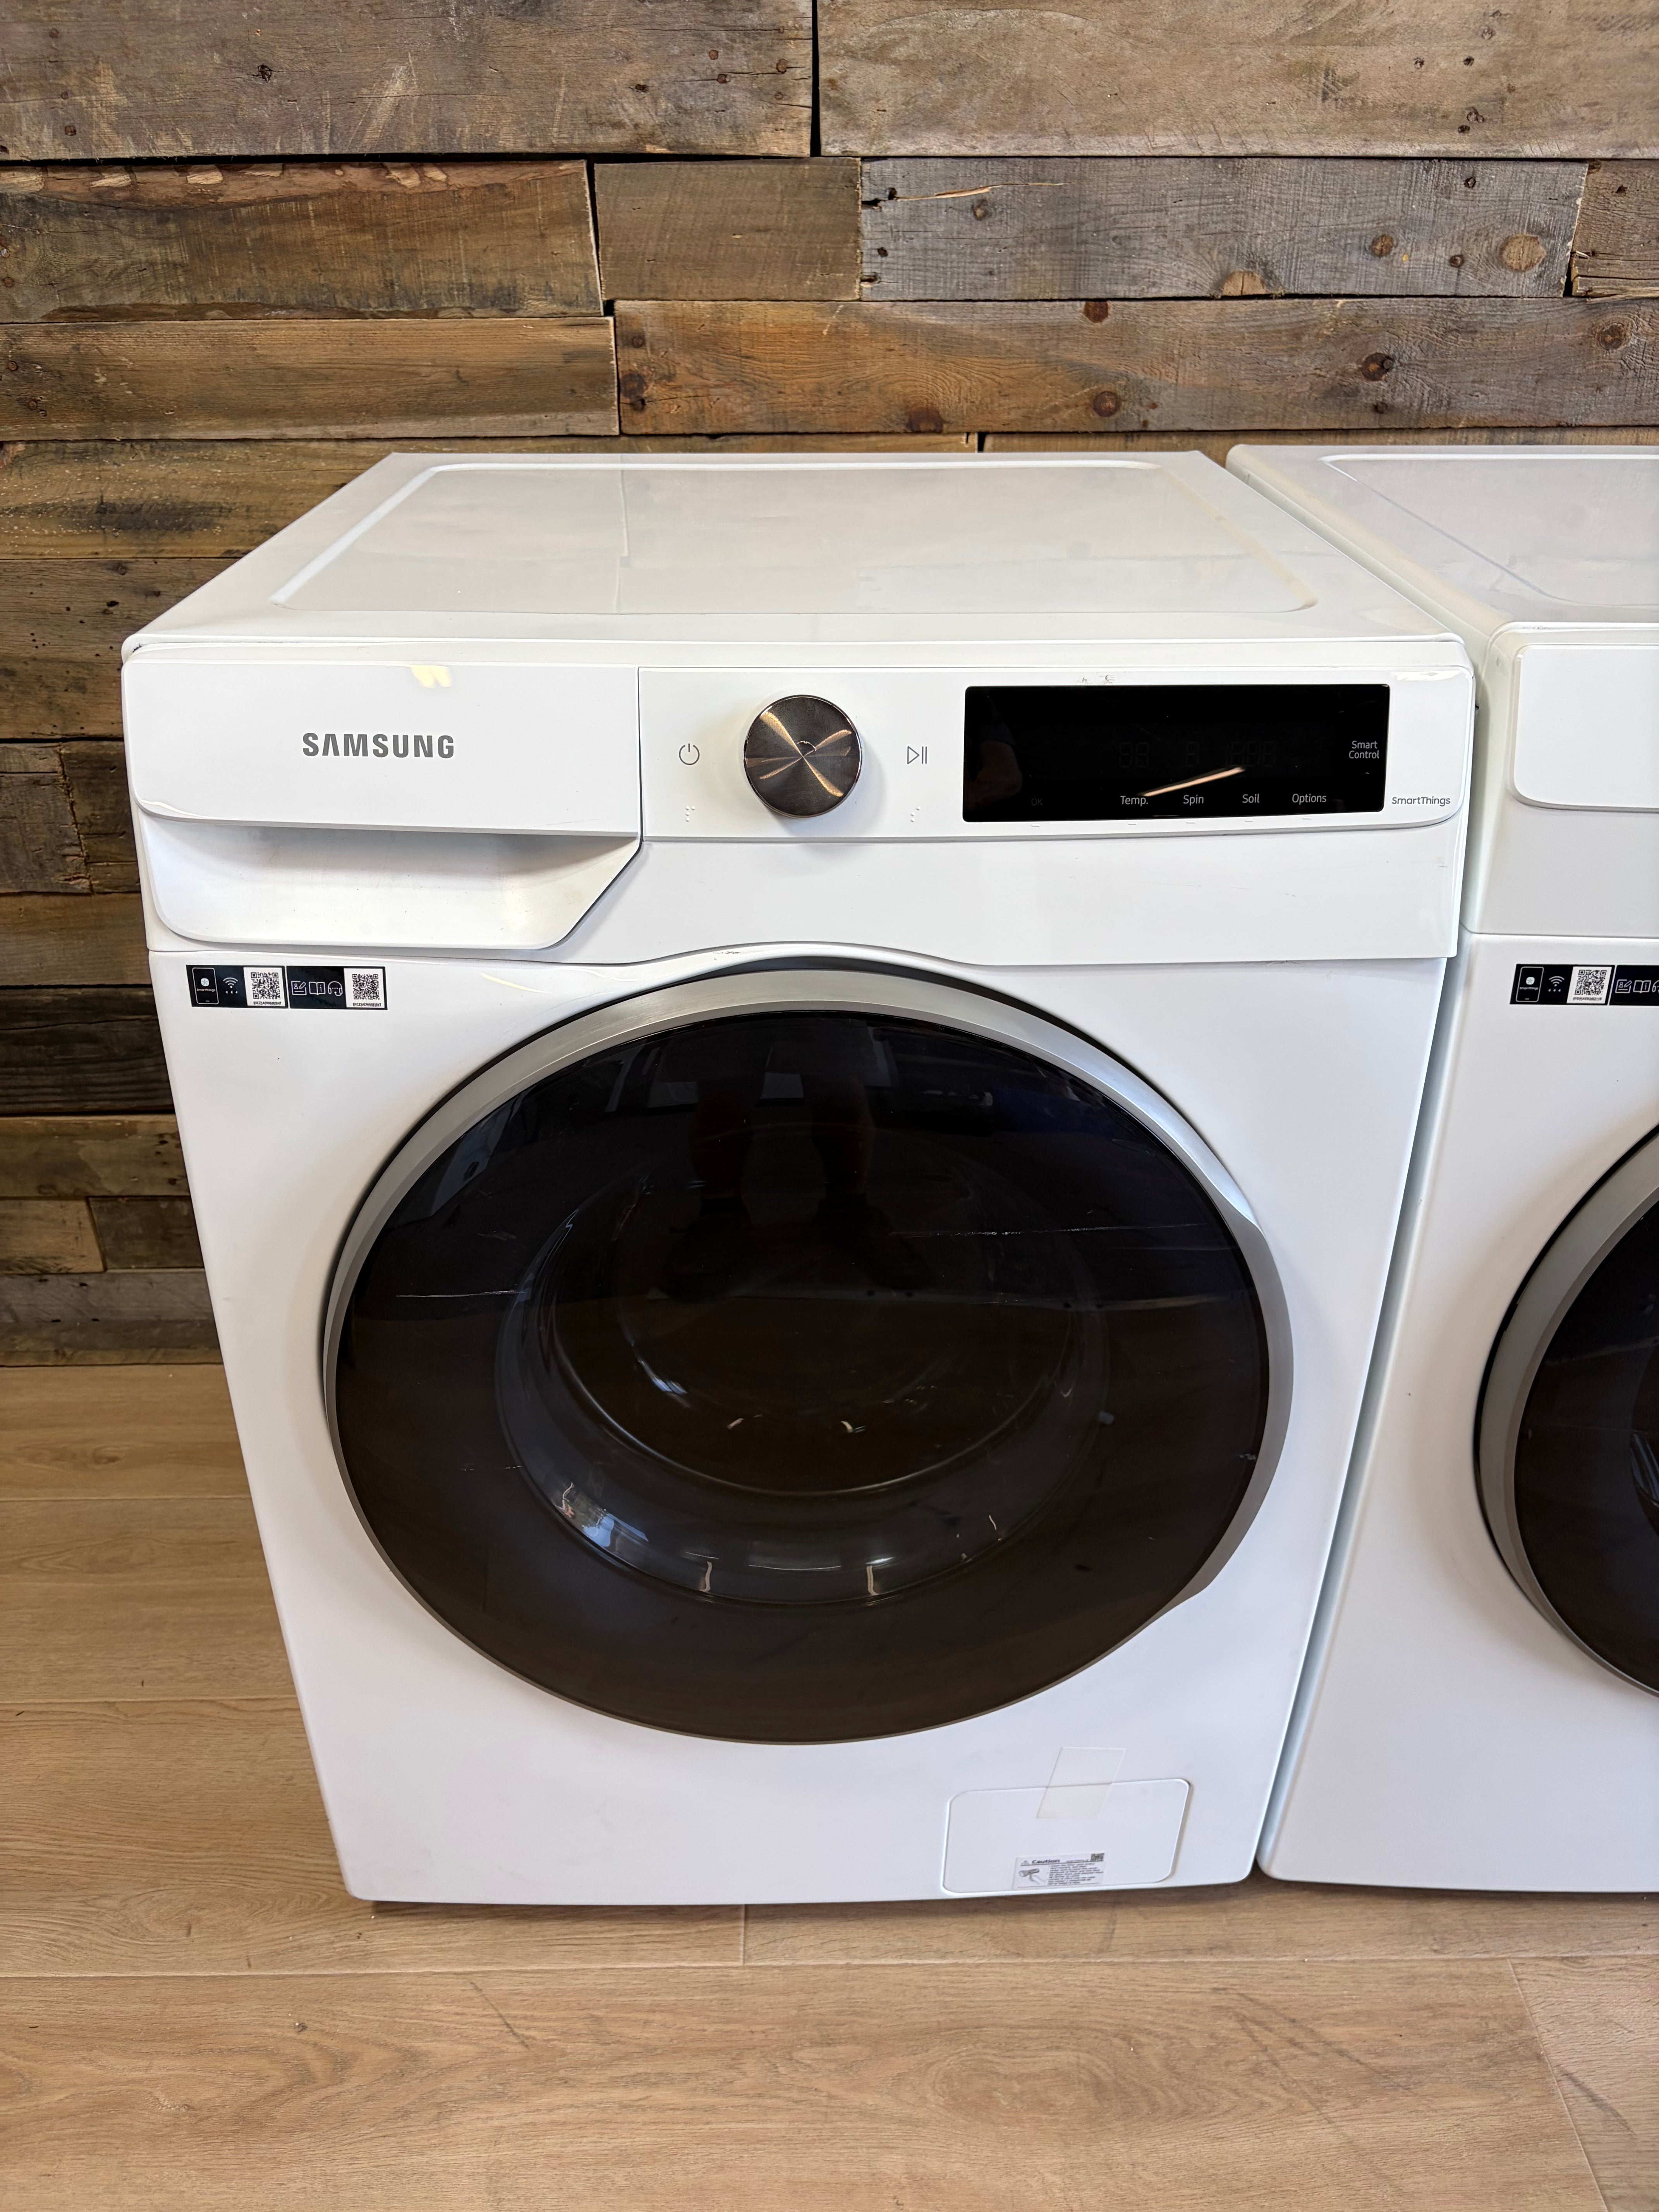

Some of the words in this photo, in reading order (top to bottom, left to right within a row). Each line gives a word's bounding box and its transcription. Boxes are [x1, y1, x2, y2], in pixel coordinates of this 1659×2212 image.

[302, 732, 454, 759] SAMSUNG
[1352, 740, 1378, 749] Smart
[1348, 750, 1379, 759] Control
[1031, 798, 1043, 806] OK
[1120, 795, 1149, 807] Temp.
[1183, 795, 1204, 806] Spin
[1242, 793, 1260, 803] Soil
[1292, 793, 1327, 805] Options
[1391, 796, 1451, 807] SmartThings
